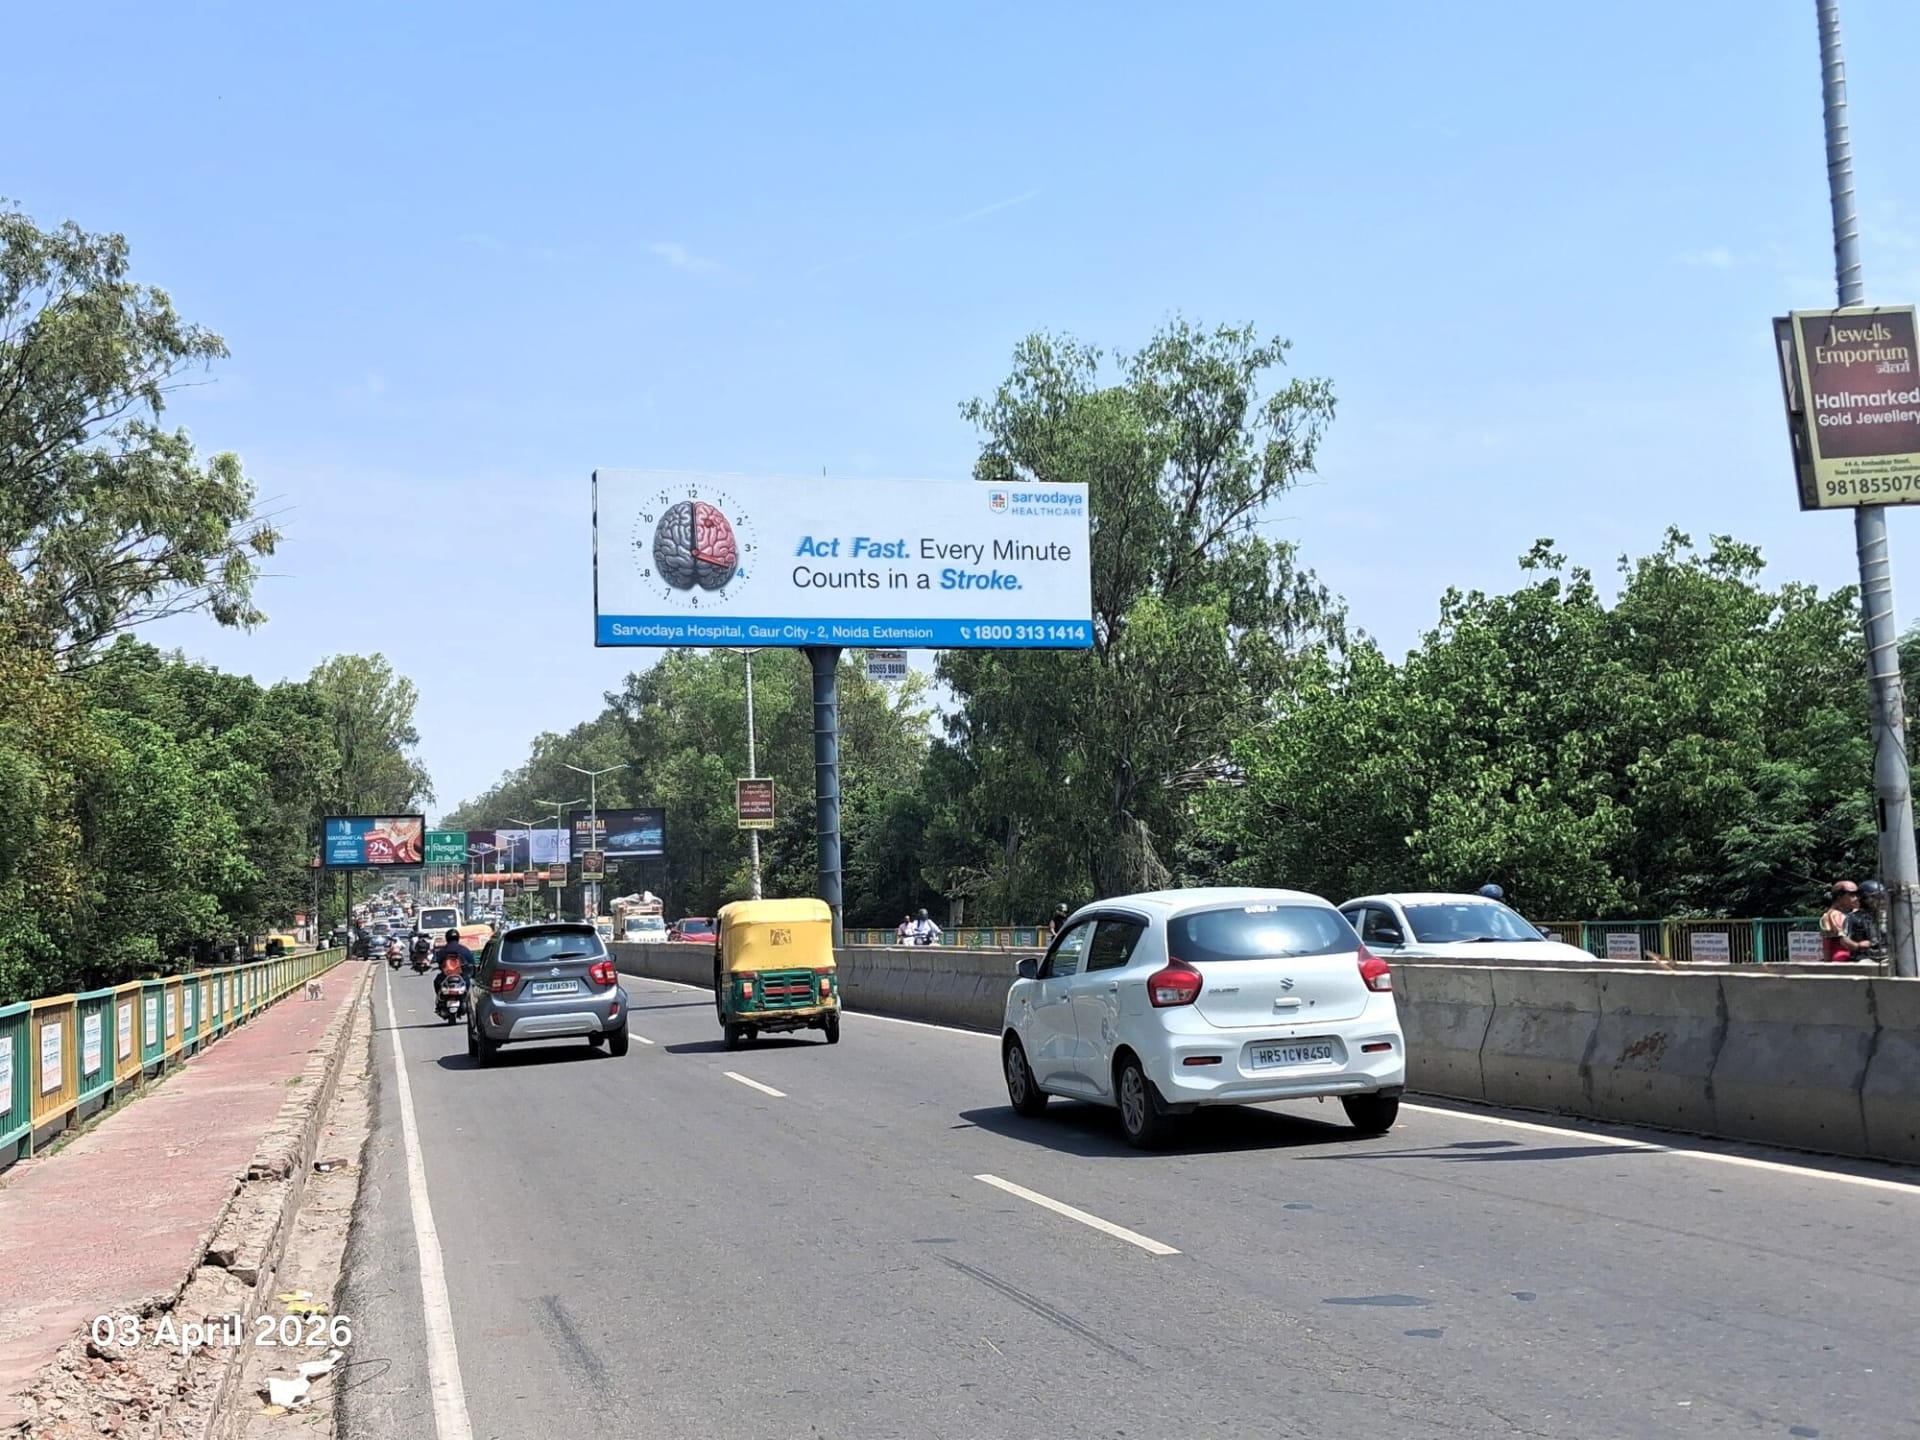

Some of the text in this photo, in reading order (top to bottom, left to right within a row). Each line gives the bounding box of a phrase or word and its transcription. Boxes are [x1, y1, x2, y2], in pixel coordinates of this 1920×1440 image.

[1829, 322, 1892, 347] Jewells
[1815, 343, 1909, 367] Emporium
[1815, 387, 1920, 409] Hallmarked
[1818, 409, 1920, 426] Gold Jewellery
[687, 489, 698, 499] 12
[1012, 492, 1082, 506] sarvodaya
[660, 496, 669, 505] 11
[718, 498, 722, 507] 1
[1012, 507, 1084, 517] HEALTHCARE
[643, 514, 653, 523] 10
[736, 517, 743, 526] 2
[636, 540, 643, 549] 9
[744, 544, 751, 552] 3
[796, 536, 1071, 565] Act Fast. Every Minute
[644, 568, 651, 577] 8
[736, 567, 745, 579] 4
[792, 566, 1023, 591] Counts in a Stroke.
[664, 587, 671, 597] 7
[719, 589, 726, 598] 5
[691, 596, 698, 605] 6
[612, 623, 684, 640] Sarvodaya
[687, 624, 745, 639] Hospital,
[749, 625, 780, 638] Gaur
[832, 626, 869, 639] Noida
[873, 626, 933, 639] Extension
[973, 626, 1085, 640] 1800 313 1414
[576, 819, 605, 830] RENAL
[1260, 1046, 1331, 1064] HR51CV8450
